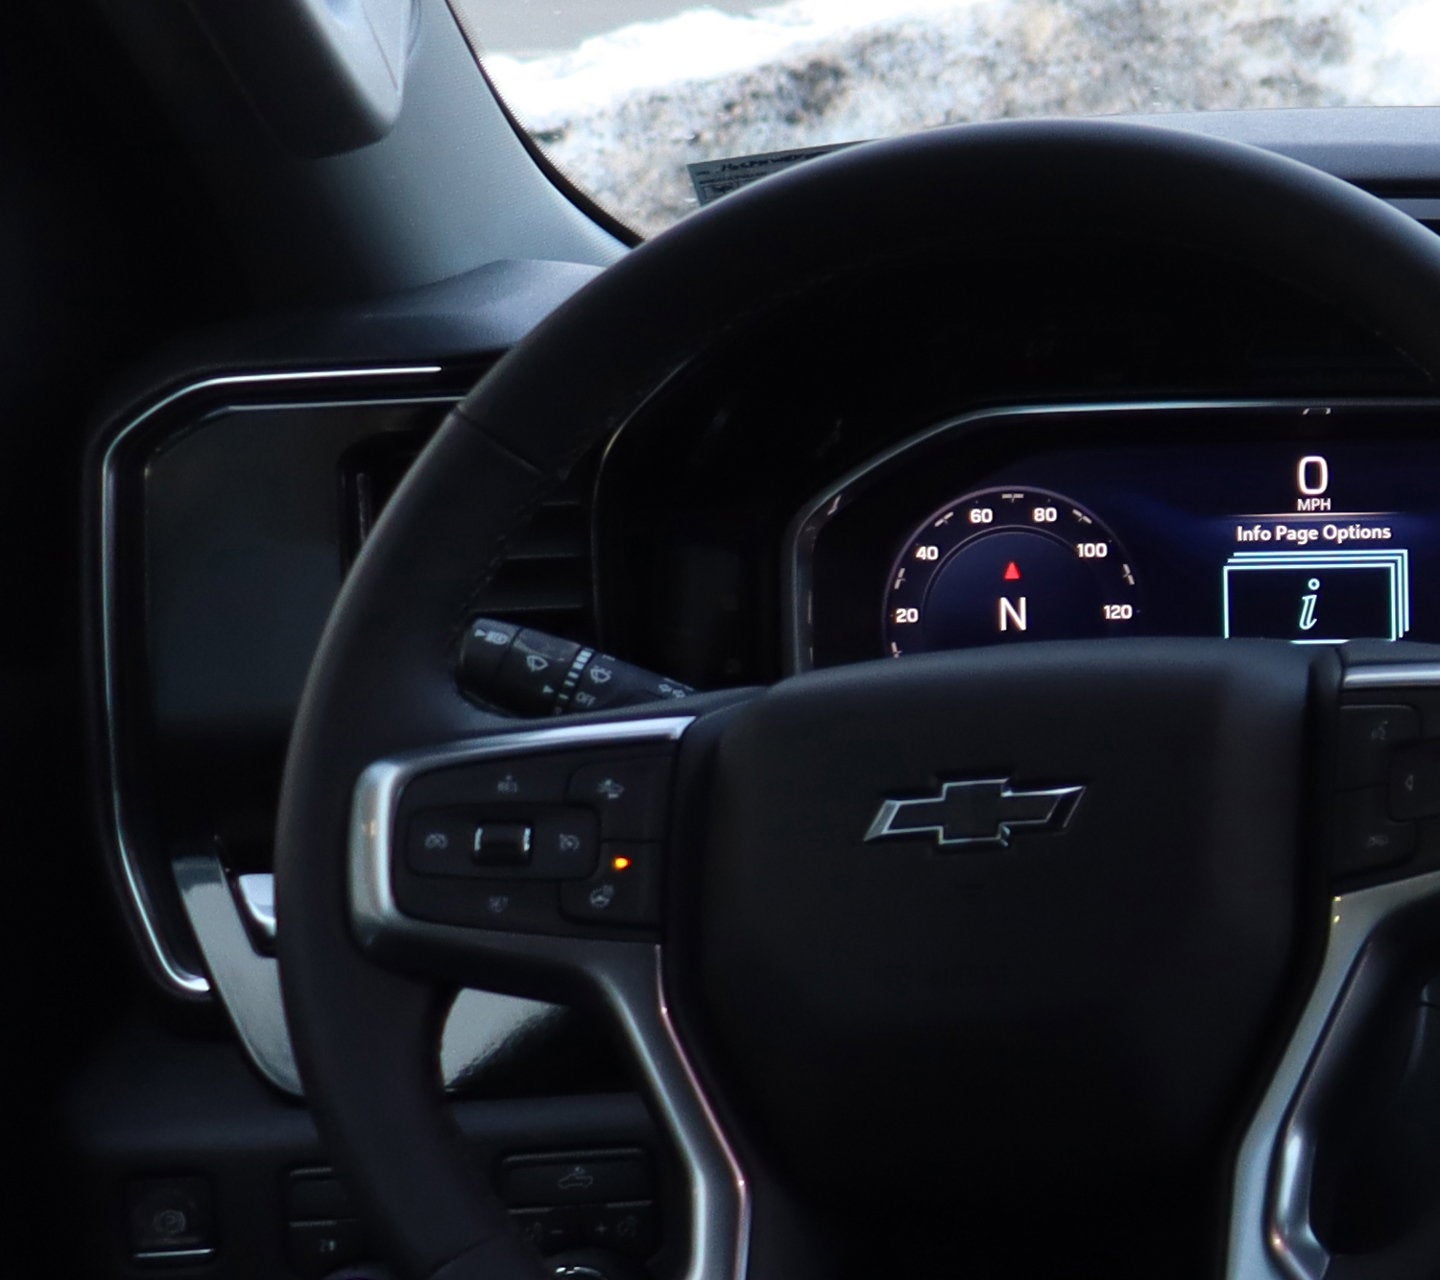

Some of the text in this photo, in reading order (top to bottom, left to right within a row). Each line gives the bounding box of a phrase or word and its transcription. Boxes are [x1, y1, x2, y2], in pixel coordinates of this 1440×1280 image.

[1297, 456, 1330, 495] 0
[1296, 498, 1332, 512] MPH
[970, 508, 994, 524] 60
[1033, 508, 1057, 523] 80
[1236, 525, 1392, 545] Info Page Options
[915, 546, 939, 561] 40
[1076, 542, 1108, 559] 100
[894, 608, 919, 624] 20
[999, 597, 1027, 632] N
[1103, 604, 1133, 620] 120
